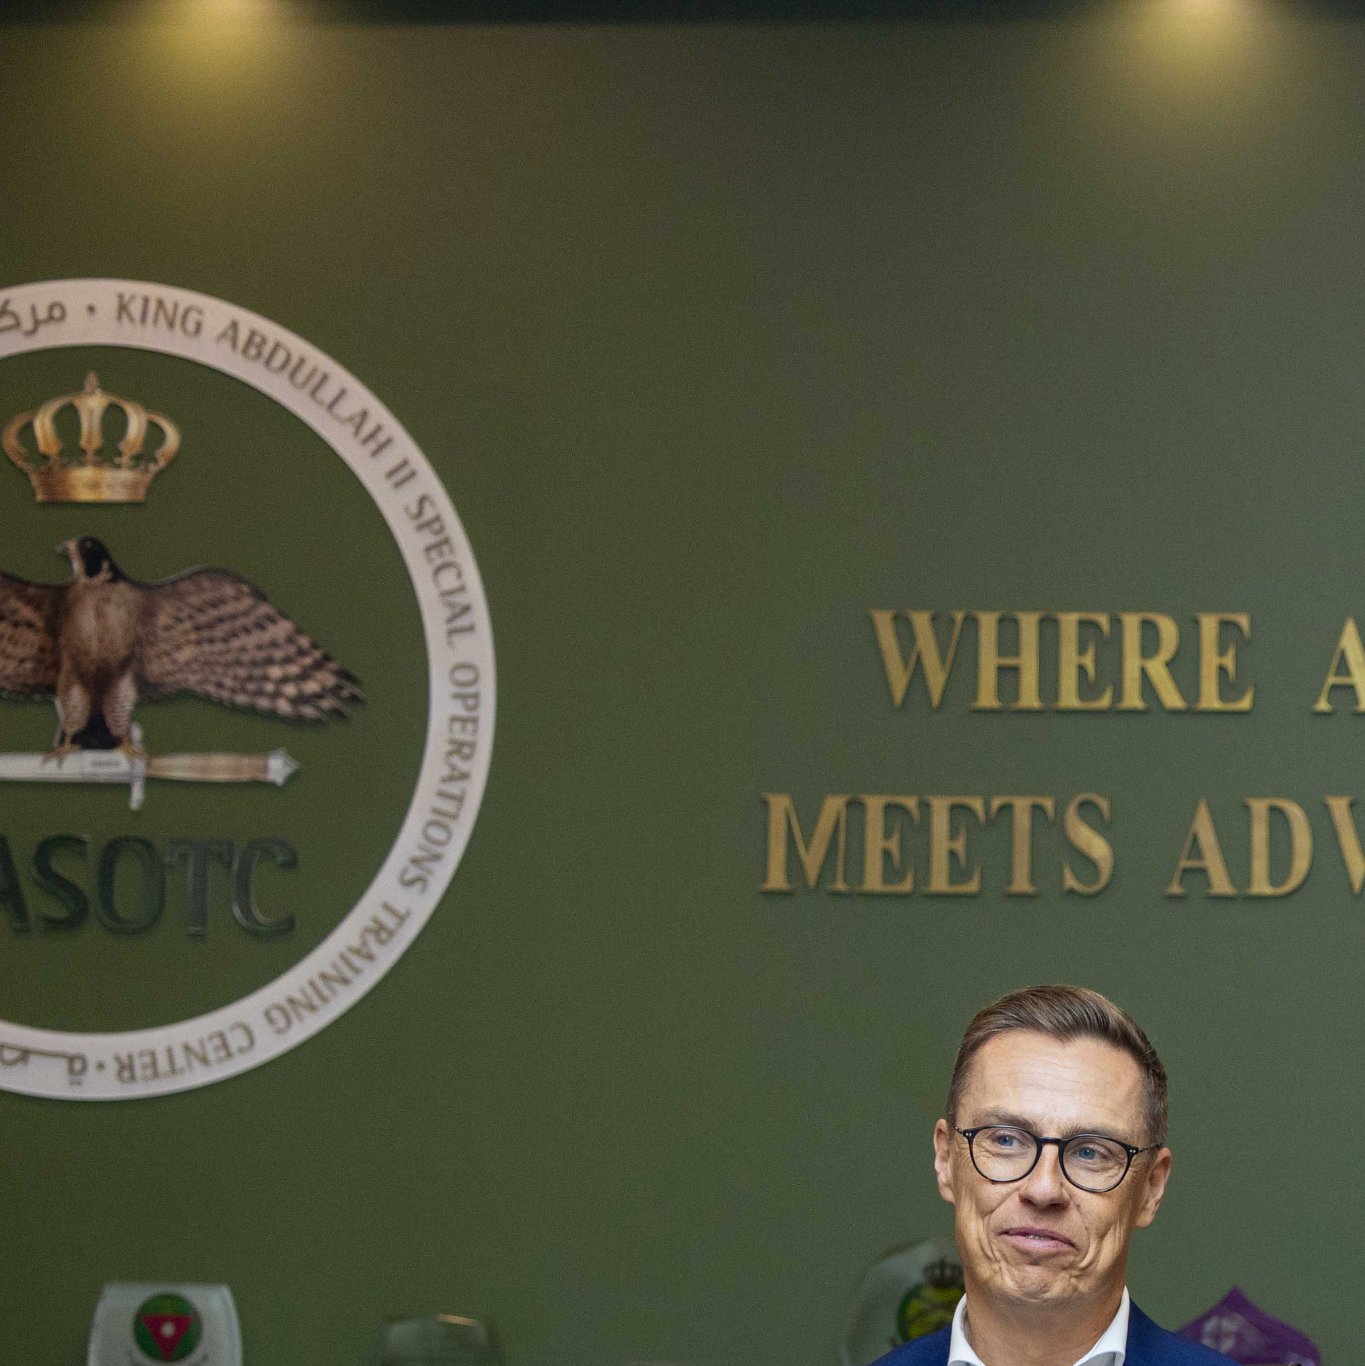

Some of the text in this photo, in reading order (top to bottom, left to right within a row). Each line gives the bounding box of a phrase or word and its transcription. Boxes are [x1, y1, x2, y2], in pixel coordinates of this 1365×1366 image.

[113, 291, 480, 1085] KING ABDULLAH II SPECIAL OPERATIONS TRAINING CENTER
[868, 609, 1256, 713] WHERE
[759, 792, 1116, 896] MEETS
